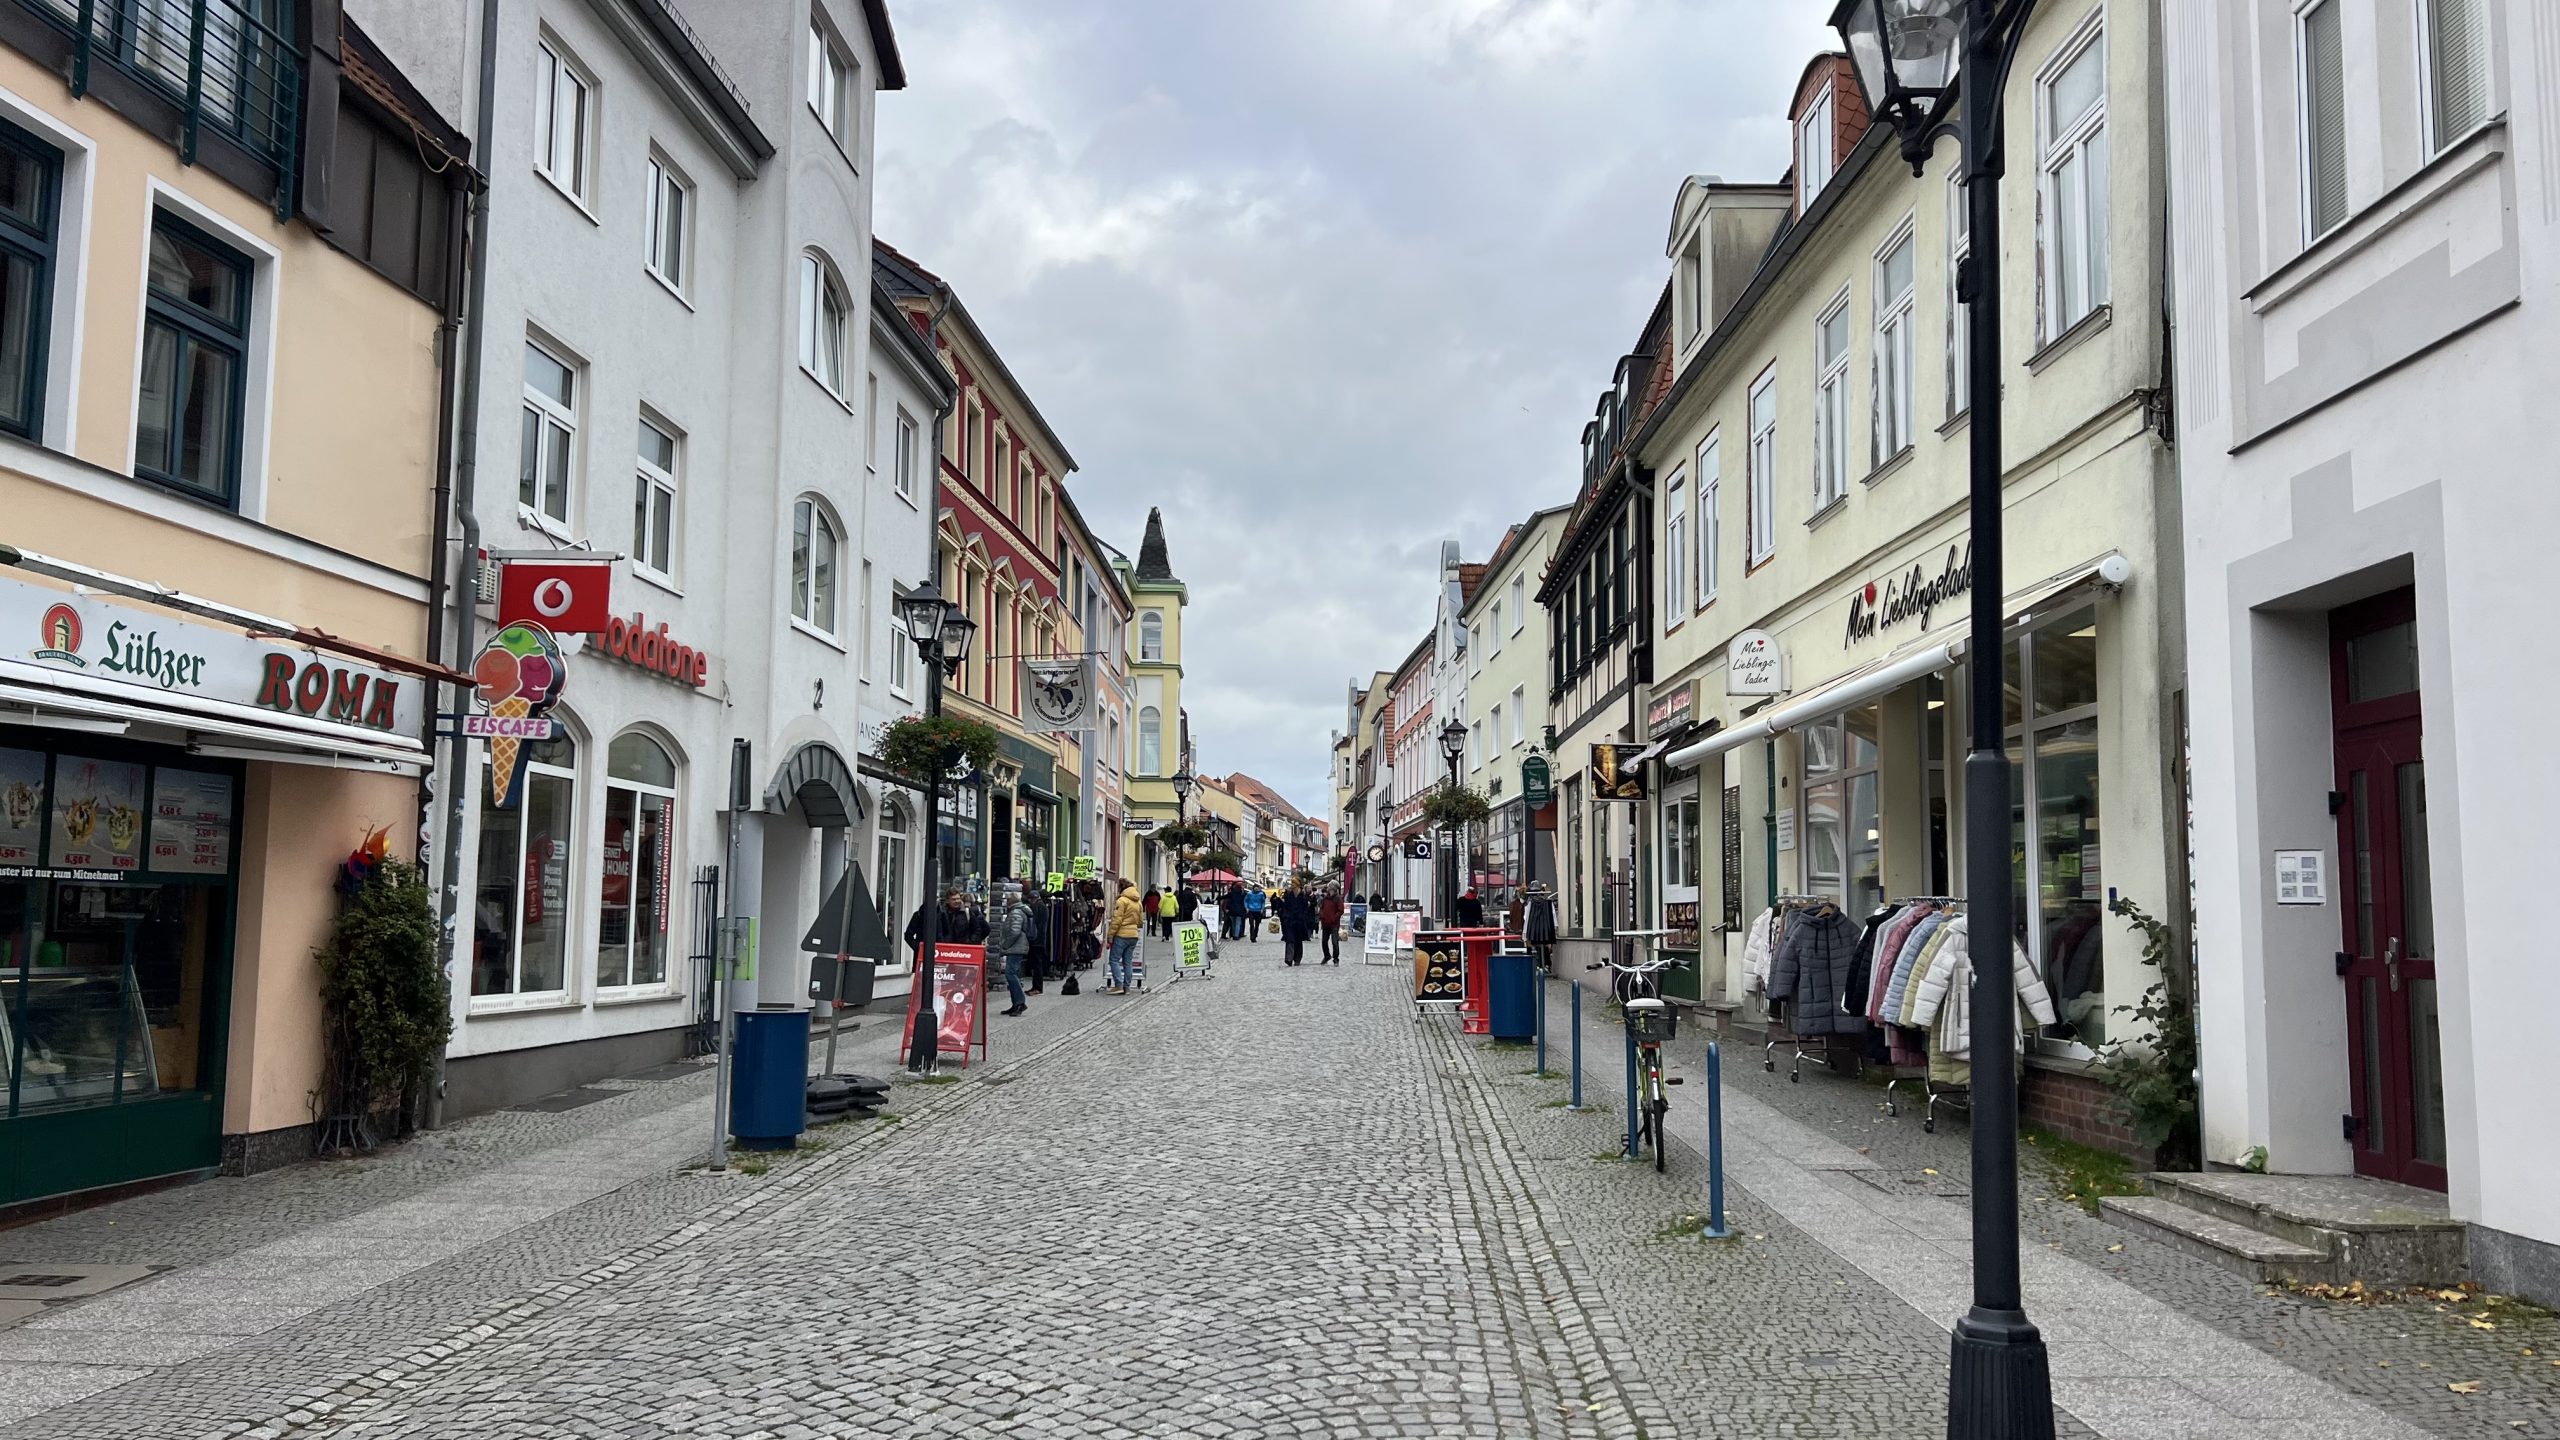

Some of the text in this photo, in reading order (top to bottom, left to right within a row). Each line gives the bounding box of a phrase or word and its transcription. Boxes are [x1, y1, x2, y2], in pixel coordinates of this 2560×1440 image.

[1844, 539, 1972, 650] Mein Lieblingslade
[98, 620, 206, 688] Lübzer
[1741, 641, 1764, 655] Mein
[1732, 657, 1776, 672] Lieblings-
[1744, 673, 1769, 684] laden
[256, 653, 399, 730] ROMA
[814, 678, 824, 711] 2
[467, 717, 548, 737] EISCAFE
[604, 848, 622, 858] ERNET
[21, 867, 33, 877] ist
[35, 869, 52, 878] nur
[53, 870, 71, 879] zum
[73, 869, 119, 880] Mitnehmen
[607, 860, 629, 876] HOME
[654, 860, 662, 916] BERATUNG
[1181, 928, 1203, 941] 70%
[940, 951, 971, 959] vodafone
